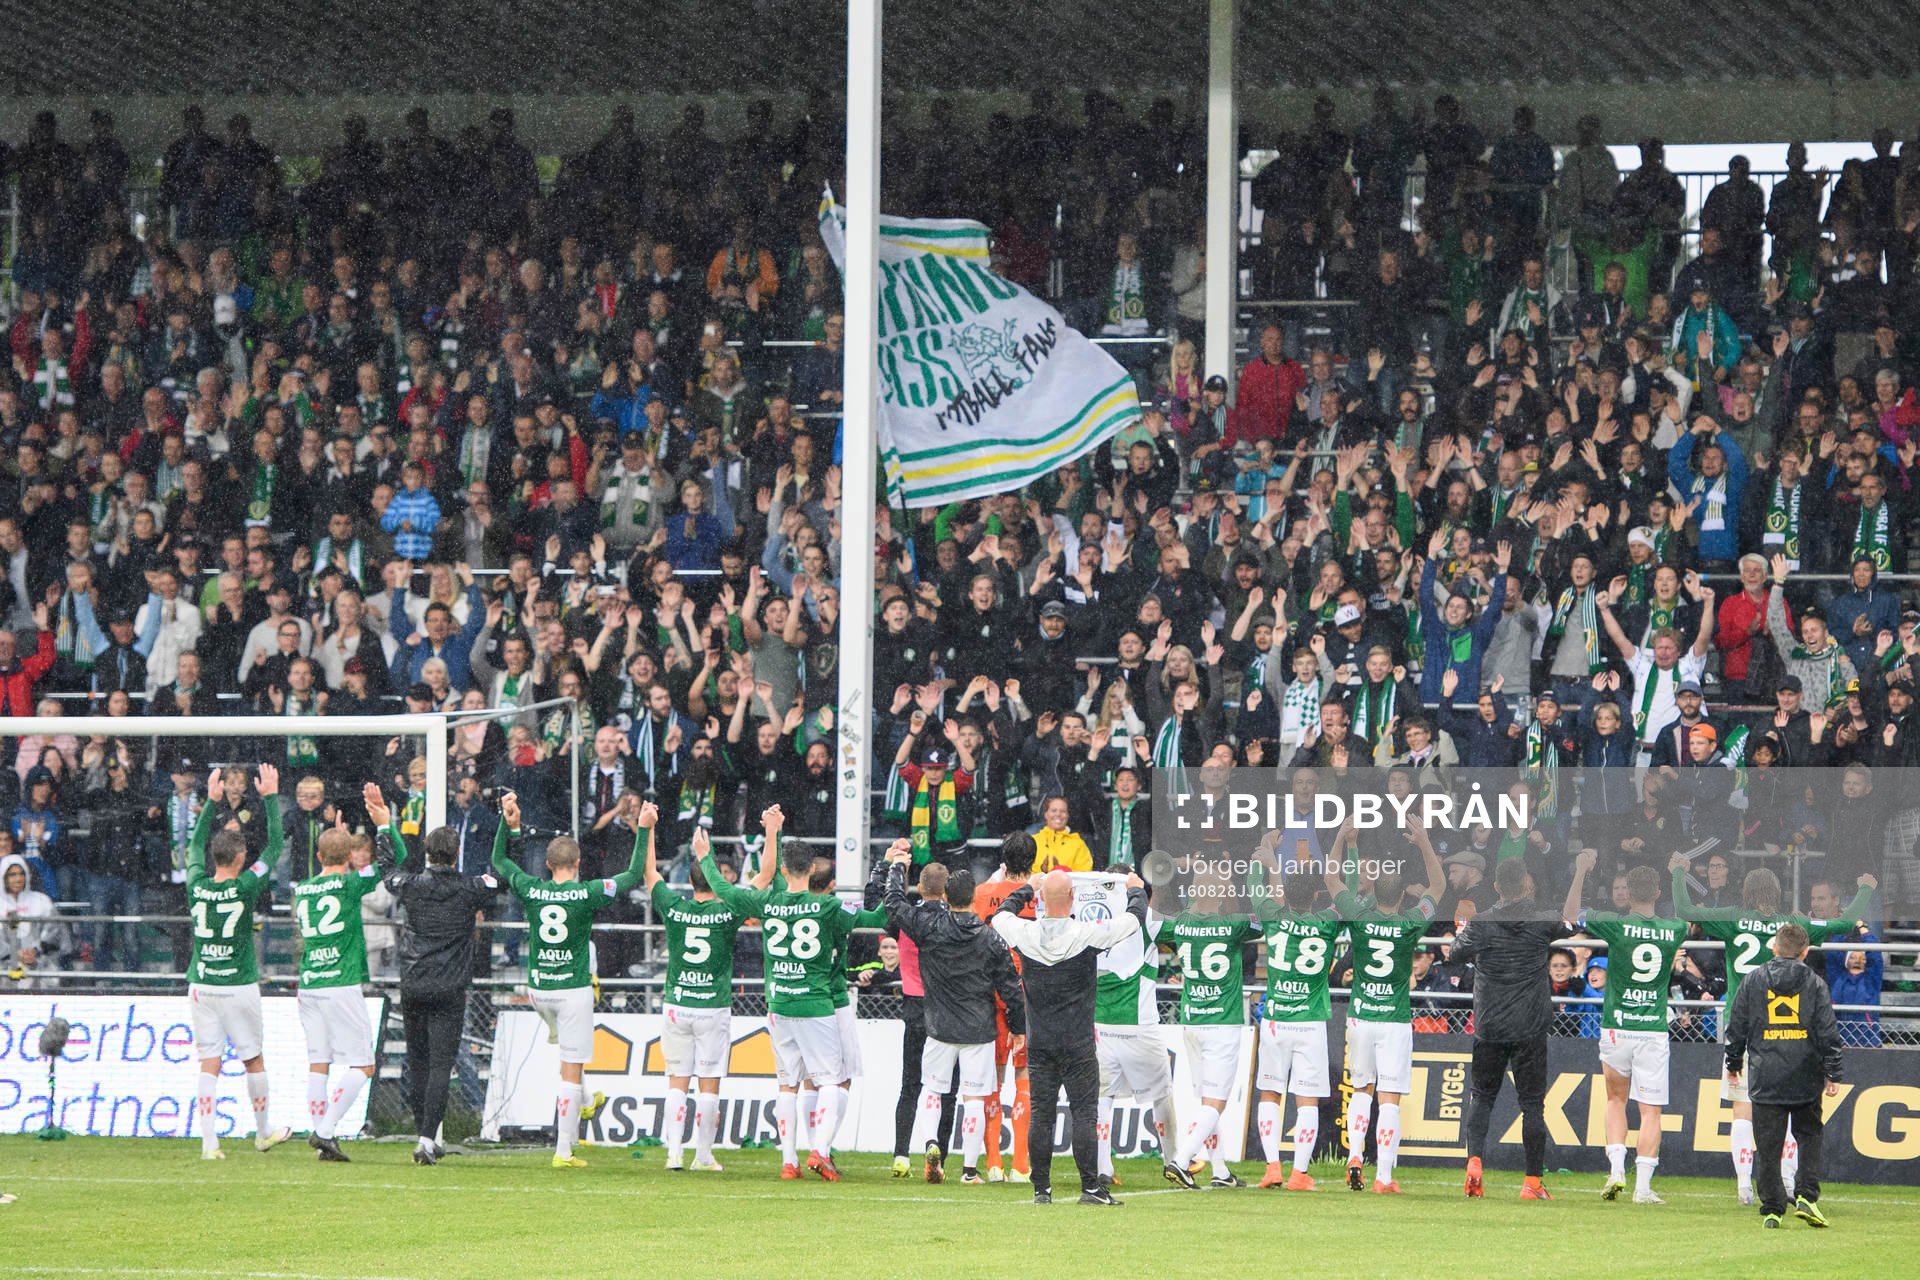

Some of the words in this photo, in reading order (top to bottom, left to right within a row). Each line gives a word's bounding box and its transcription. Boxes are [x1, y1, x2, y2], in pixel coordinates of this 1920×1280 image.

[295, 880, 344, 895] VENSSON
[297, 895, 345, 938] 12
[764, 902, 821, 916] PORTILLO
[190, 901, 245, 938] 17
[539, 905, 569, 944] 8
[1738, 918, 1790, 935] CIBIC
[764, 918, 821, 959] 28
[1364, 923, 1403, 938] SIWE
[1622, 924, 1675, 941] THELIN
[201, 944, 235, 957] AQUA
[682, 927, 712, 964] 5
[1267, 931, 1328, 975] 18
[1733, 933, 1777, 974] 2
[309, 946, 341, 962] AQUA
[537, 949, 573, 961] AQUA
[1178, 942, 1230, 980] 16
[1364, 939, 1395, 978] 3
[772, 961, 807, 974] AQUA
[1631, 943, 1663, 983] 9
[677, 971, 714, 982] AQUA
[1189, 985, 1222, 997] AQUA
[1274, 980, 1311, 994] AQUA
[1360, 982, 1395, 995] AQUA
[1763, 1029, 1808, 1040] ASPLUNDS
